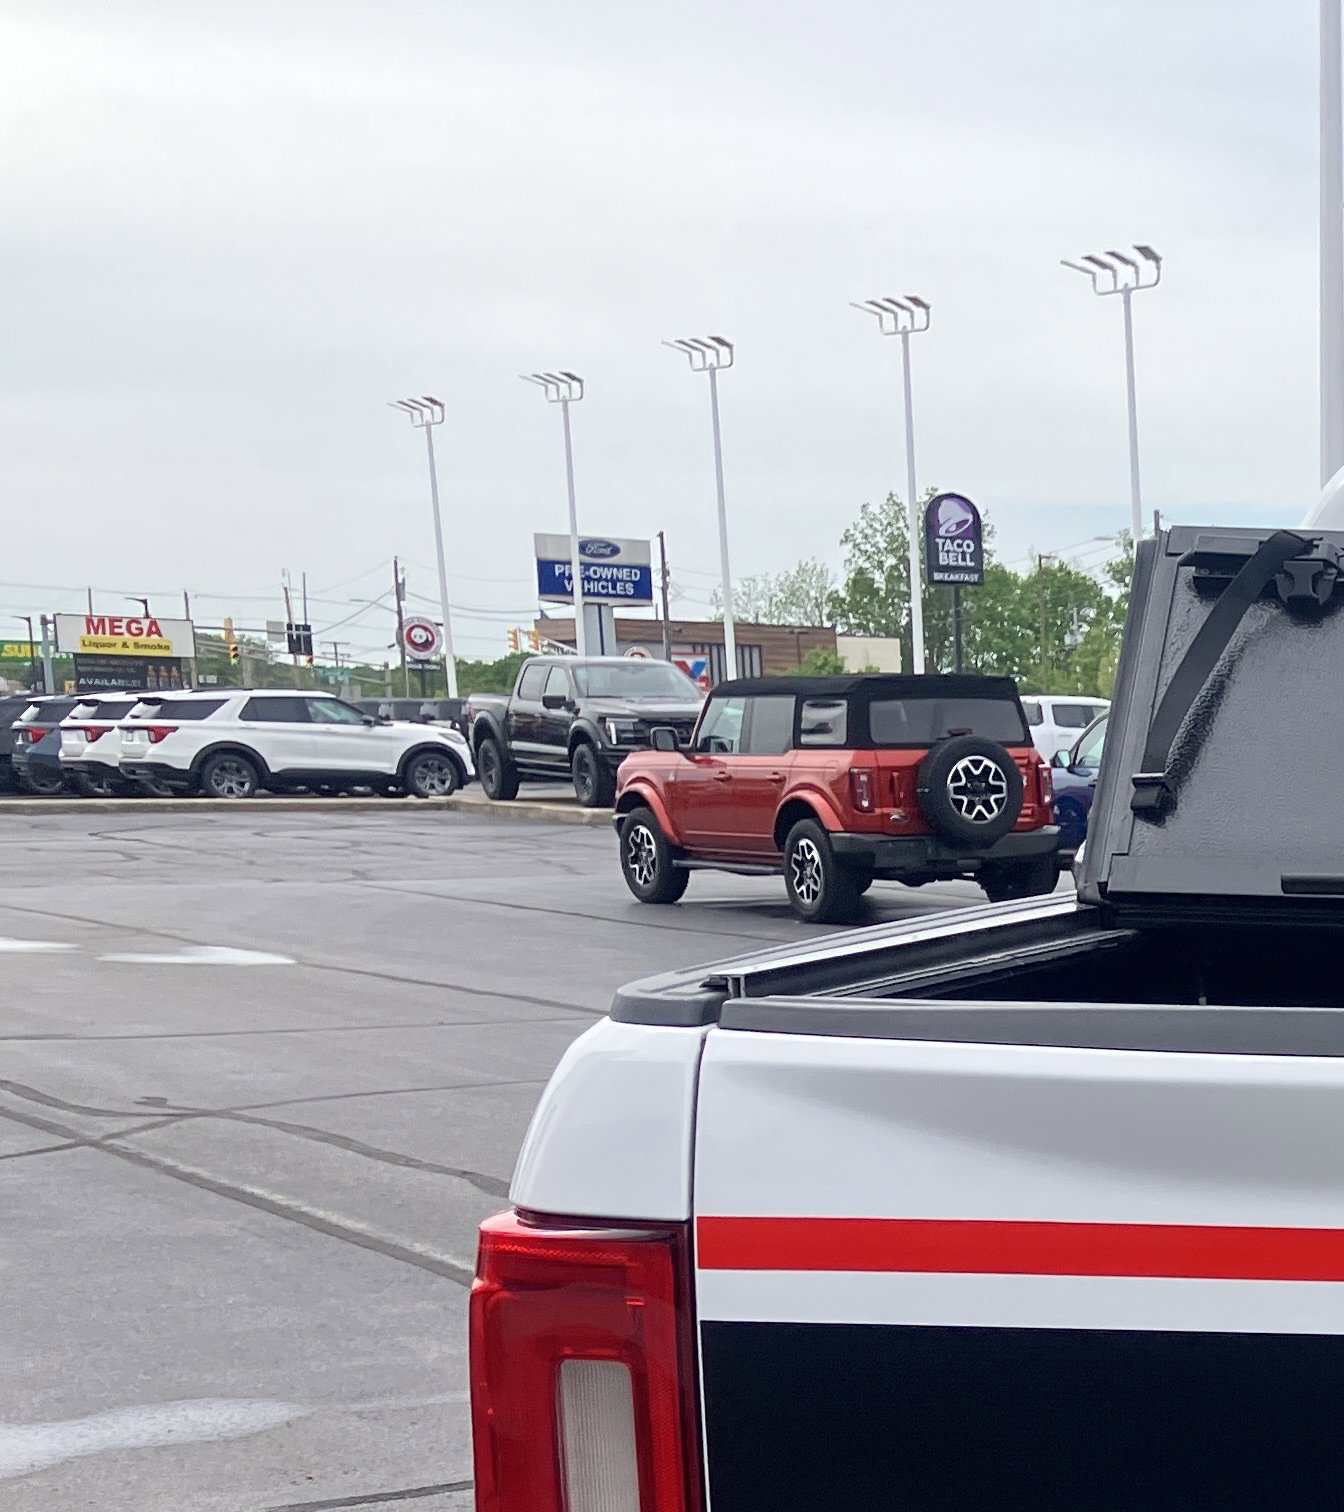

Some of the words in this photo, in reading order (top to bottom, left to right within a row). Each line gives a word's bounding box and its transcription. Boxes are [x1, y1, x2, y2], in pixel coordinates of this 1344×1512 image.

[585, 543, 613, 555] Ford
[935, 538, 975, 553] TACO
[939, 552, 975, 566] BELL
[933, 572, 980, 583] BREAKFAST
[564, 580, 634, 595] VHICLES
[85, 617, 163, 638] MEGA
[81, 639, 117, 650] Liquor
[134, 642, 171, 651] Smoke
